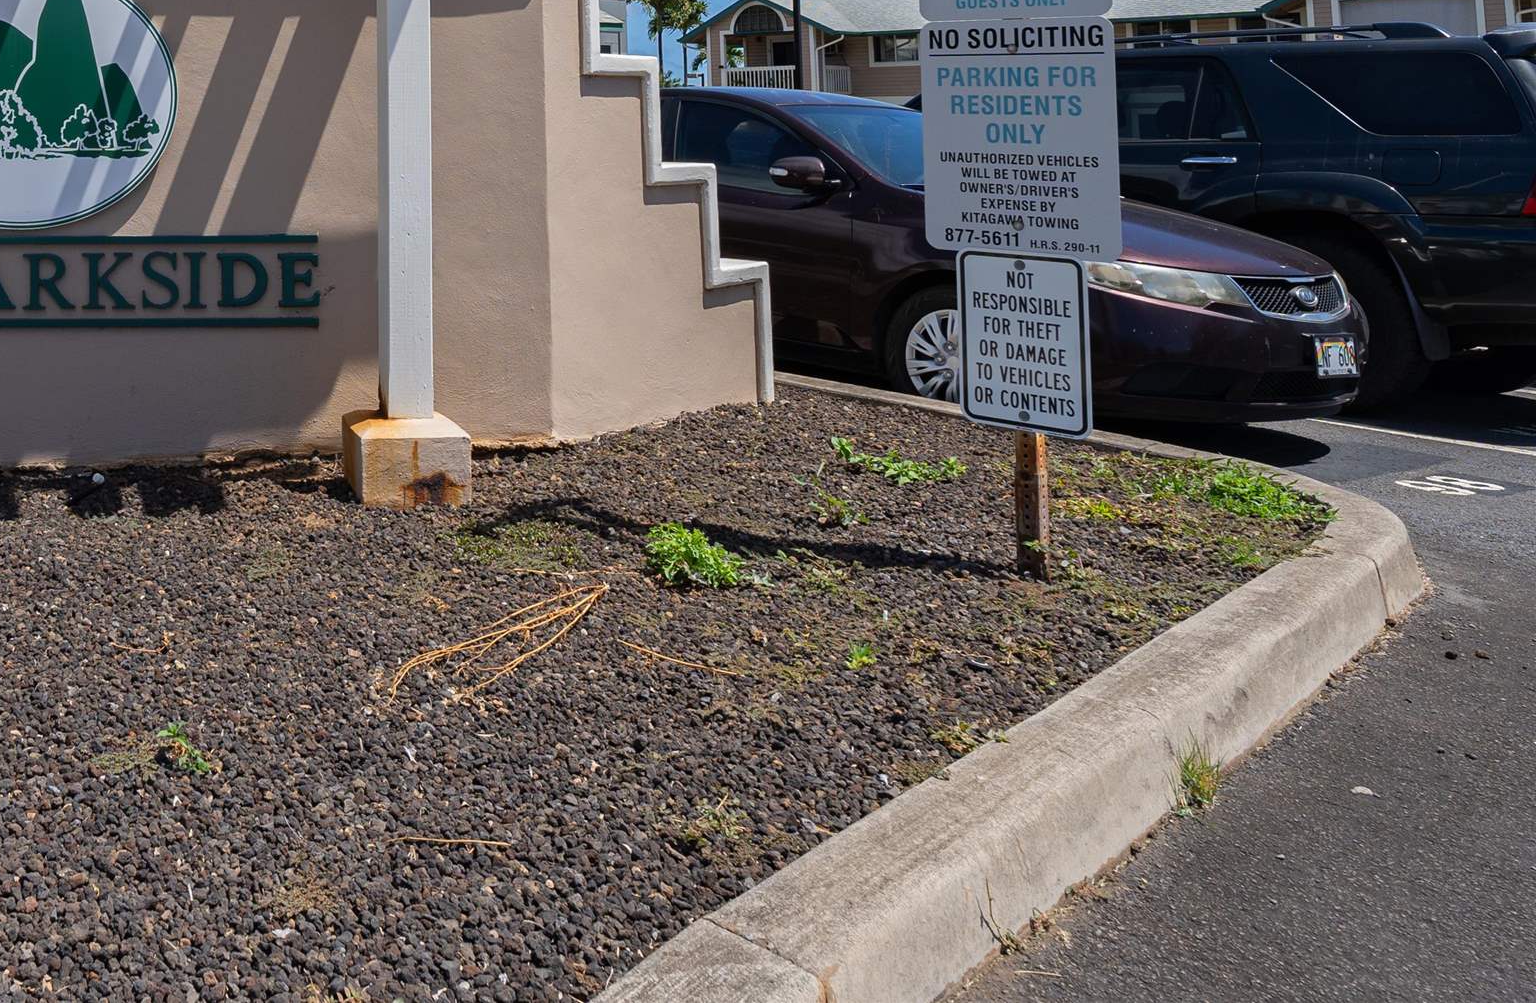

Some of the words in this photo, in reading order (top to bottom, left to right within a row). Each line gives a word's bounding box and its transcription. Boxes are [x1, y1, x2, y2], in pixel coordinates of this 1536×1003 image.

[929, 29, 959, 49] NO
[968, 25, 1104, 49] SOLICITING
[937, 66, 1039, 87] PARKING
[1048, 66, 1096, 87] FOR
[951, 95, 1082, 116] RESIDENTS
[986, 123, 1045, 144] ONLY
[940, 151, 1033, 166] UNAUTHORIZED
[1037, 155, 1099, 168] VEHICLES
[961, 167, 990, 179] WILL
[994, 168, 1008, 180] BE
[1013, 169, 1057, 182] TOWED
[1061, 172, 1076, 183] AT
[960, 182, 1079, 199] OWNER'S/DRIVER'S
[981, 198, 1037, 212] EXPENSE
[1040, 201, 1056, 212] BY
[961, 212, 1023, 227] KITAGAWA
[1027, 216, 1079, 230] TOWING
[945, 228, 1020, 246] 877-5611
[1031, 240, 1061, 251] H.R.S.
[1064, 242, 1100, 253] 290-11
[1006, 271, 1034, 290] NOT
[973, 291, 1072, 318] RESPONSIBLE
[984, 316, 1010, 335] FOR
[1017, 320, 1061, 341] THEFT
[979, 339, 998, 358] OR
[1006, 343, 1067, 367] DAMAGE
[976, 362, 992, 380] TO
[1000, 365, 1071, 392] VEHICLES
[975, 386, 993, 405] OR
[1000, 390, 1075, 417] CONTENTS
